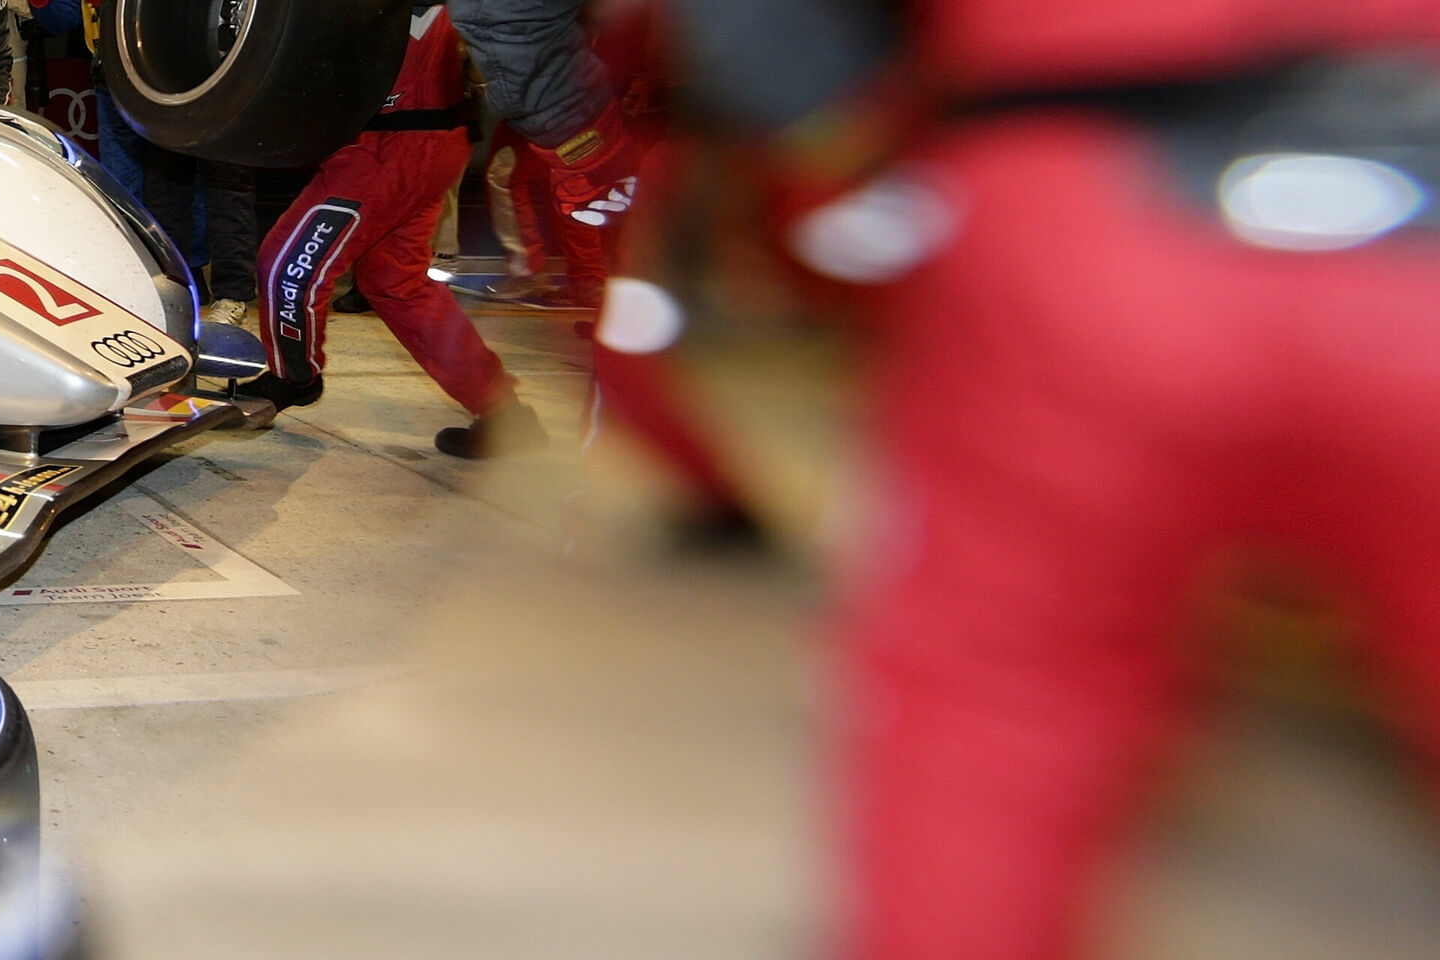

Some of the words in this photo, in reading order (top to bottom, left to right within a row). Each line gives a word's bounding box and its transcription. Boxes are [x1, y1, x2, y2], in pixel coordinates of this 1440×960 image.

[287, 223, 333, 279] Sport
[280, 280, 299, 322] Audi
[40, 586, 86, 594] Audi
[91, 585, 154, 593] Sport
[43, 593, 103, 601] Team
